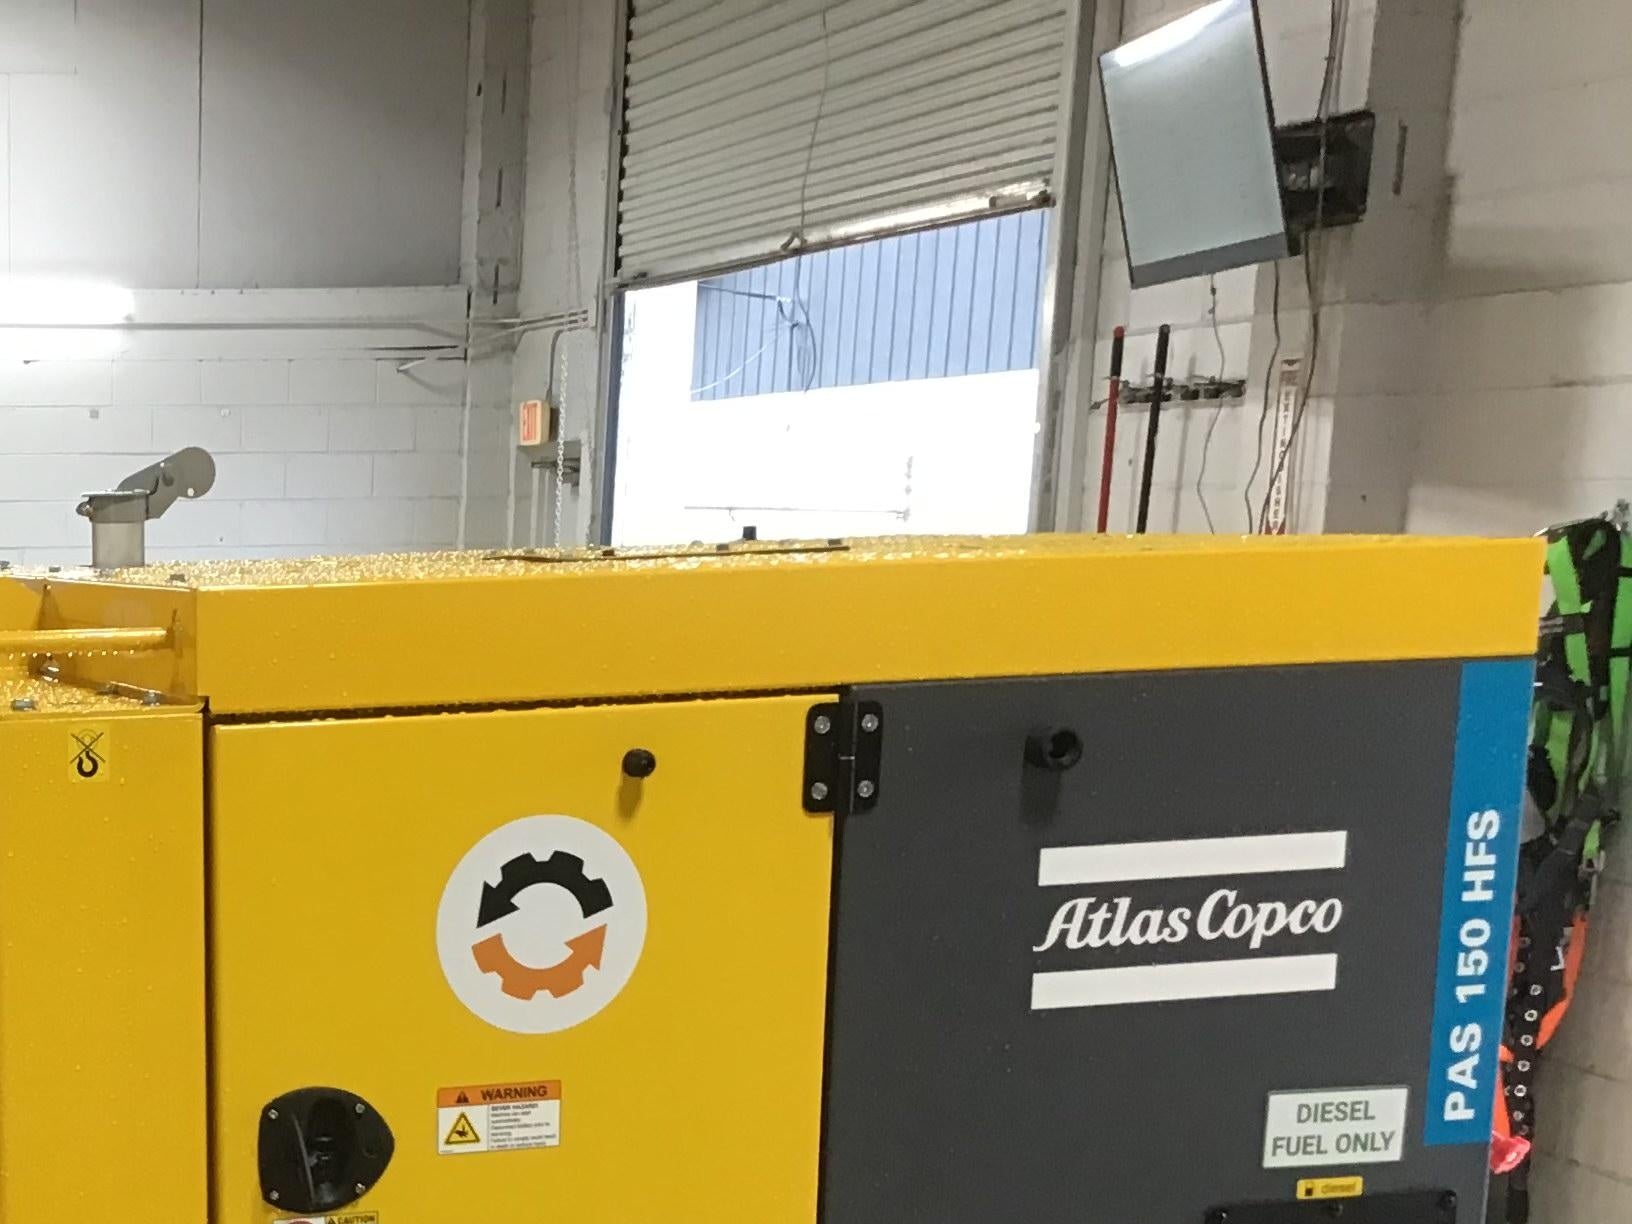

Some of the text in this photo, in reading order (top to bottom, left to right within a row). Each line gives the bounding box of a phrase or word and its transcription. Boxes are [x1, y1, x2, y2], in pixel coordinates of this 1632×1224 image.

[1032, 888, 1344, 952] Atlas Copco
[1443, 807, 1501, 1122] PAS 150 HFS
[480, 1085, 548, 1101] WARNING
[1296, 1100, 1376, 1124] DIESEL
[1271, 1130, 1396, 1157] FUEL ONLY
